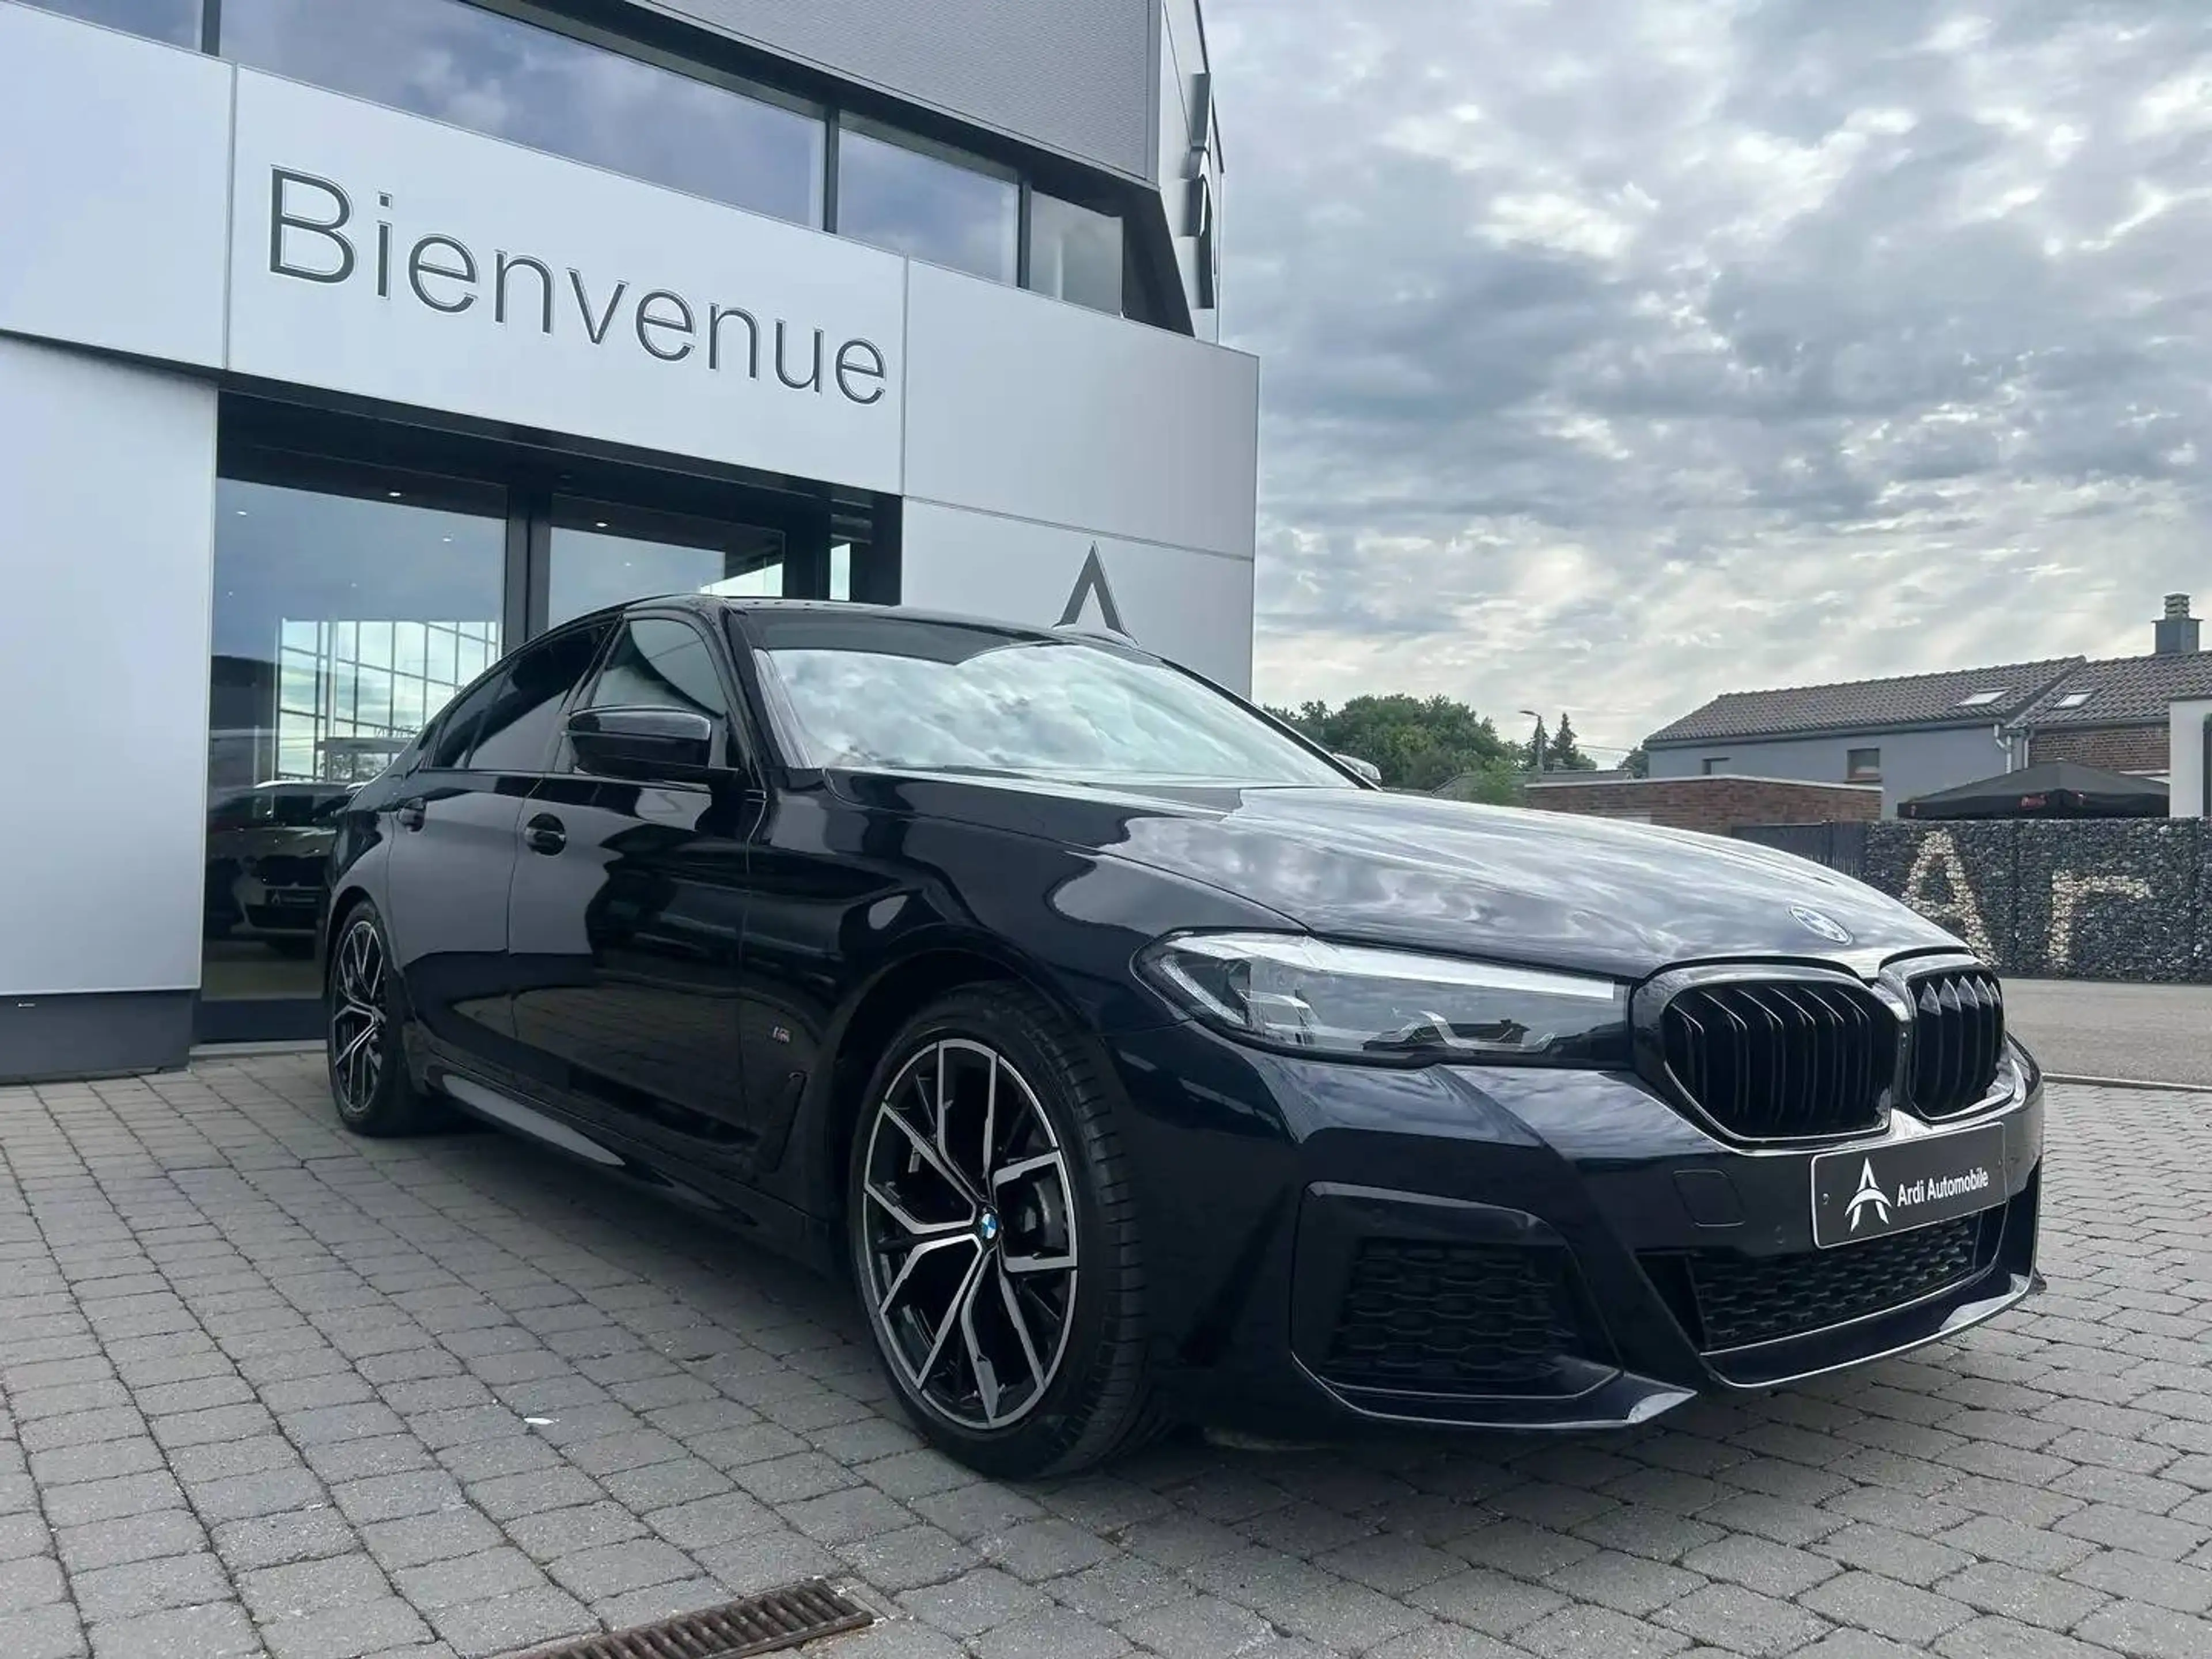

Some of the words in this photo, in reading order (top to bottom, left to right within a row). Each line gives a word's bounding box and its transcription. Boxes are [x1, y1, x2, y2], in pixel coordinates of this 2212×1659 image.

[268, 164, 886, 406] Bienvenue
[1897, 1180, 1925, 1207] Ardi
[1927, 1167, 1988, 1200] Automobile
